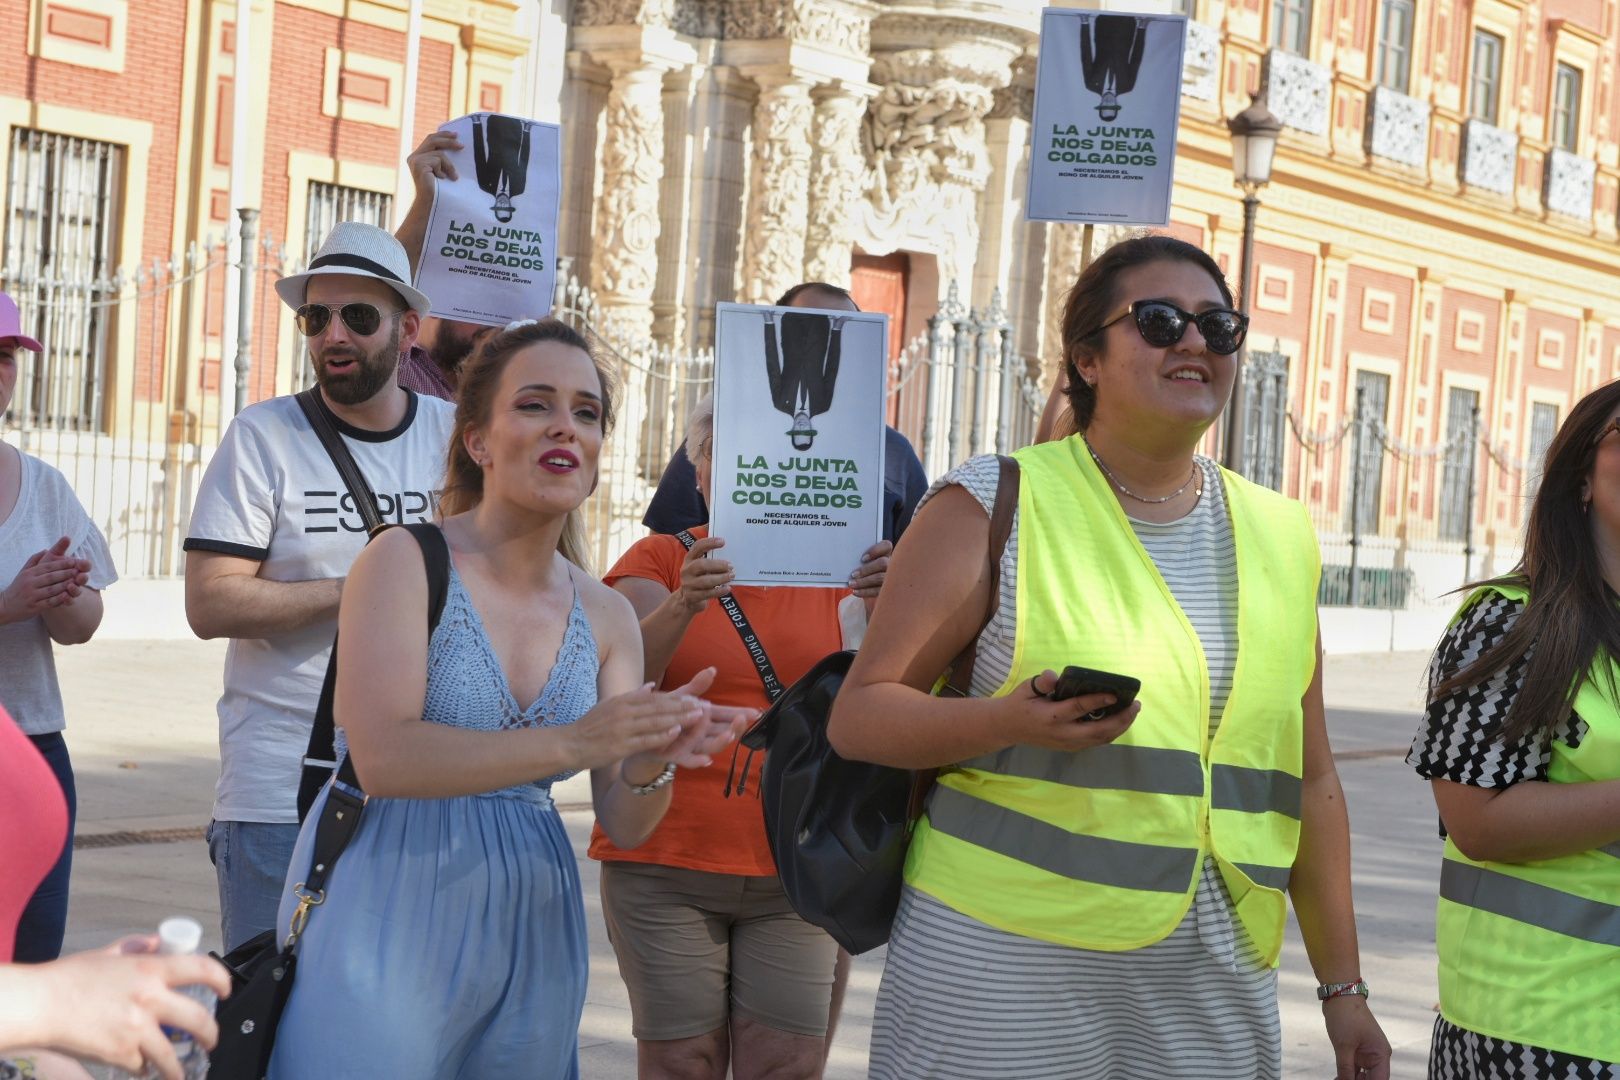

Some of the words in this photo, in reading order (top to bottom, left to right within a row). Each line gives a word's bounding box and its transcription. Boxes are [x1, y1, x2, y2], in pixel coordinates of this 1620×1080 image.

[1053, 124, 1079, 136] LA
[1087, 126, 1155, 139] JUNTA
[1051, 138, 1094, 150] NOS
[1101, 140, 1154, 153] DEJA
[1048, 151, 1158, 167] COLGADOS
[1073, 167, 1120, 175] NECESITAMOS
[449, 220, 476, 235] LA
[483, 226, 543, 244] JUNTA
[446, 233, 490, 250] NOS
[494, 240, 541, 257] DEJA
[440, 246, 544, 271] COLGADOS
[464, 264, 511, 277] NECESITAMOS
[480, 272, 511, 282] ALQUILER
[737, 455, 769, 469] LA
[778, 457, 858, 473] JUNTA
[736, 473, 787, 488] NOS
[795, 475, 858, 491] DEJA
[732, 490, 863, 509] COLGADOS
[304, 490, 444, 533] ESPRI
[764, 512, 819, 520] NECESITAMOS
[721, 596, 746, 628] FOREV
[745, 635, 769, 671] YOUNG
